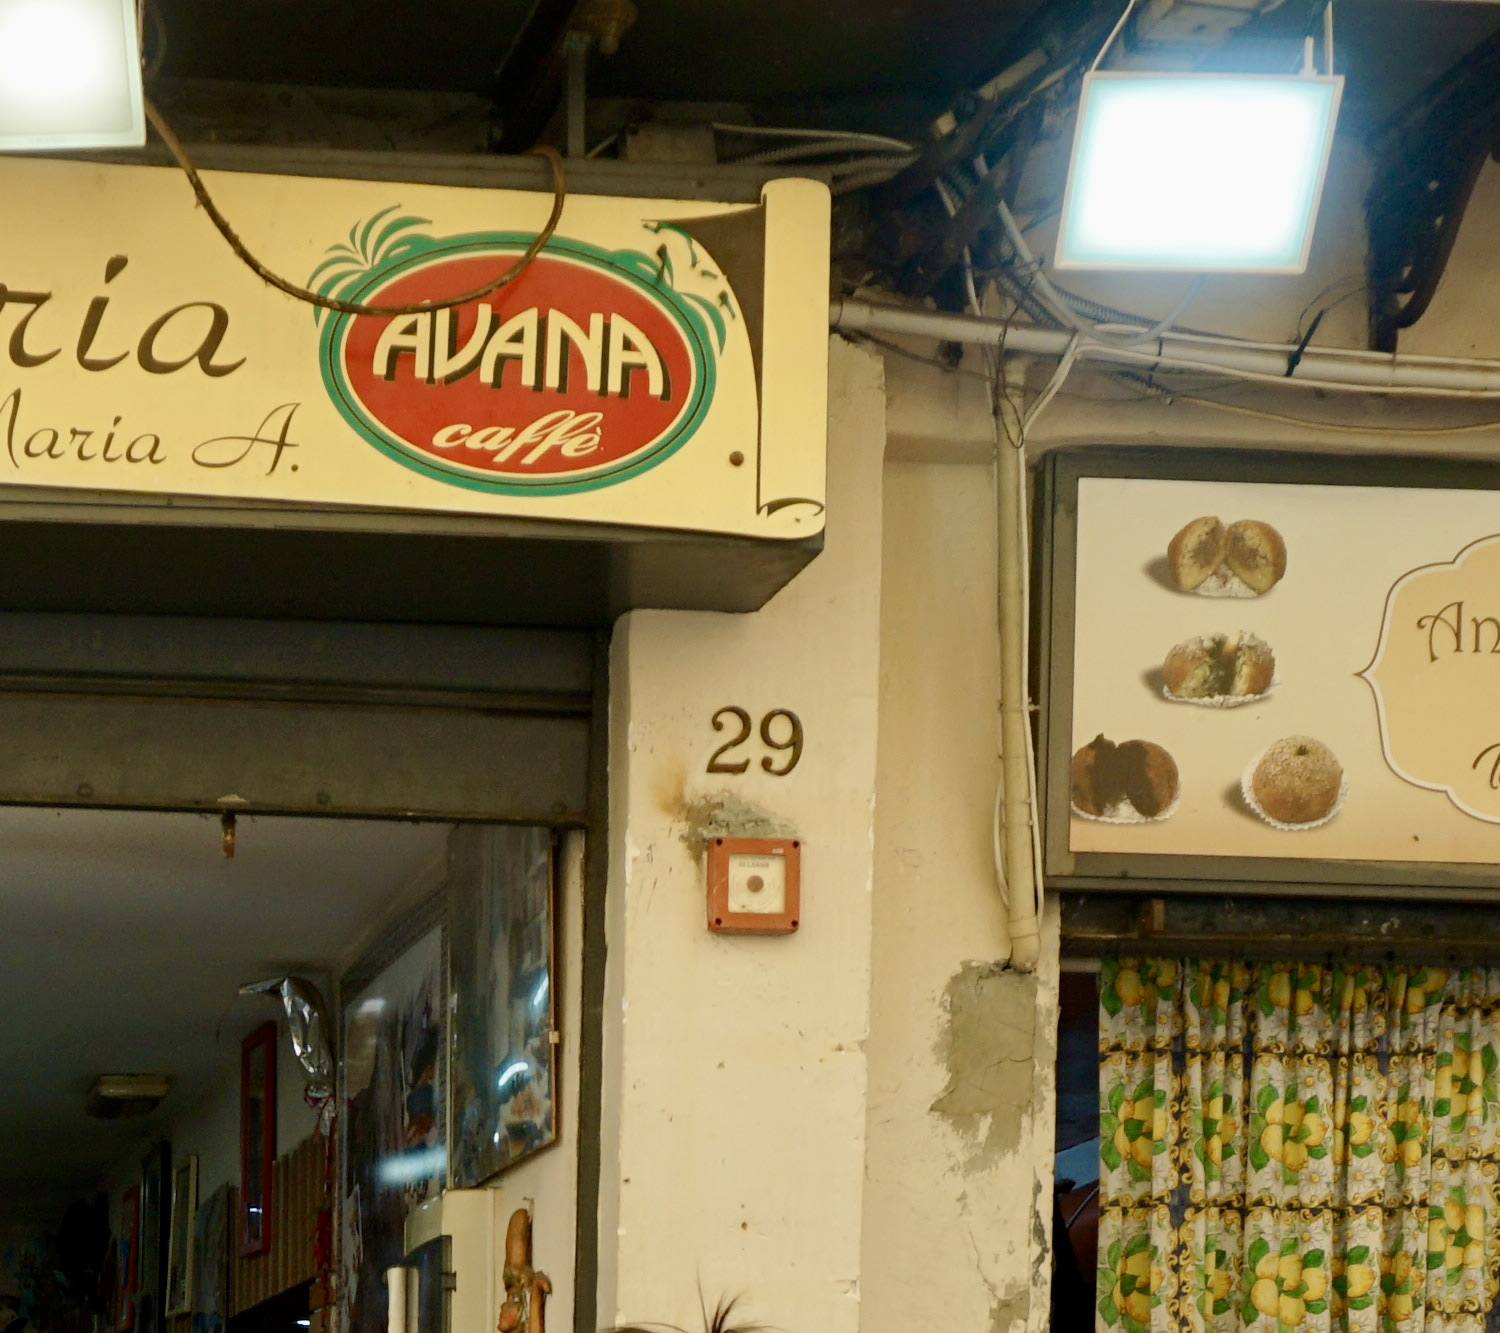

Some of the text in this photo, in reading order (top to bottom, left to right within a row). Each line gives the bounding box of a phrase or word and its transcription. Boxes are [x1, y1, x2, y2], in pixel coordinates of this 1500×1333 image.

[373, 300, 671, 400] AVANA
[192, 402, 302, 476] A.
[432, 409, 604, 465] caffè
[706, 705, 804, 777] 29
